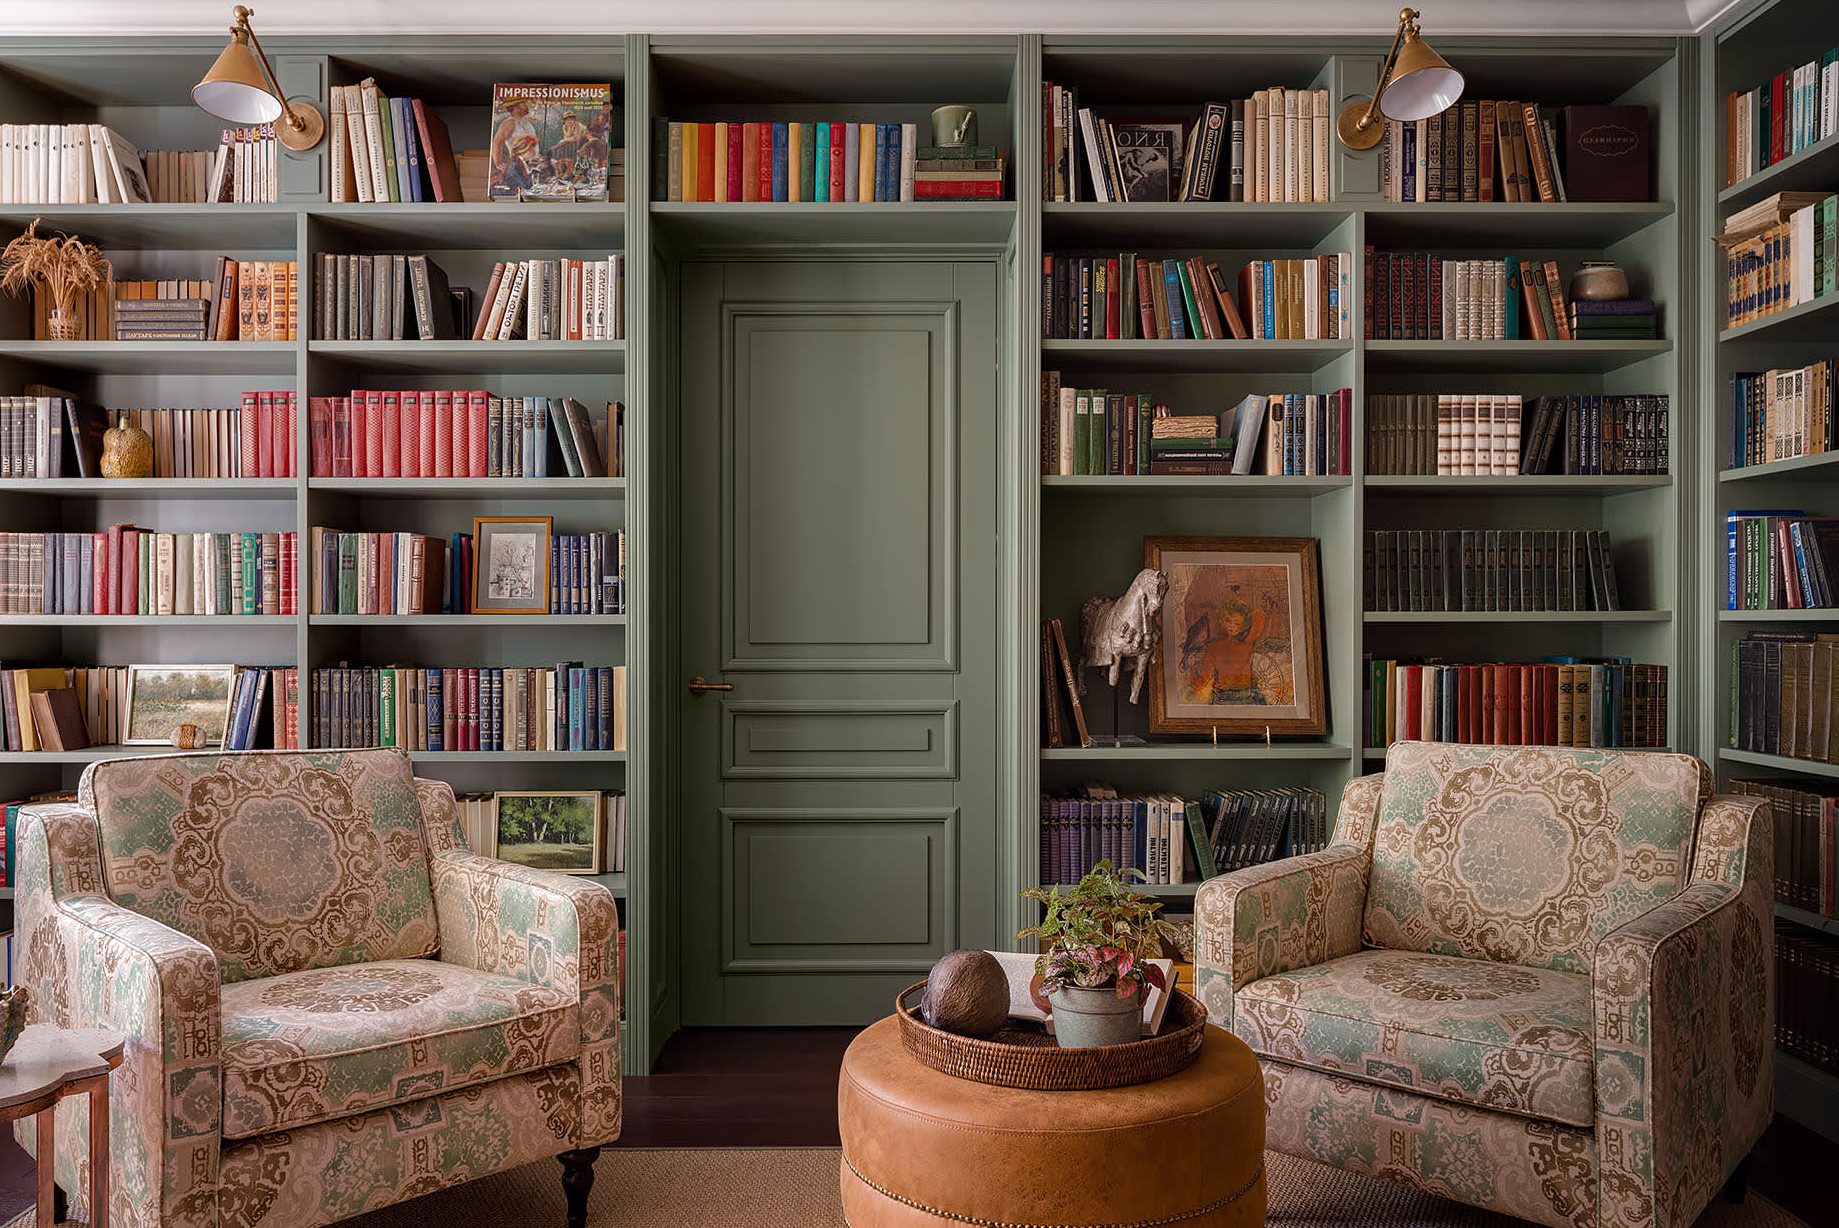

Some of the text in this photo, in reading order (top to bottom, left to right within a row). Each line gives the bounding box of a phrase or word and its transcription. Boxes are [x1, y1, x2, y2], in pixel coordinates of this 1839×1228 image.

[499, 88, 604, 98] IMPRESSIONISMUS
[598, 268, 606, 310] ПЛУТАРХ
[1377, 257, 1386, 326] ШЕКСПИР
[1392, 258, 1400, 326] ШЕКСПИР
[1404, 258, 1413, 326] ШЕКСПИР
[1417, 257, 1426, 326] ШЕКСПИР
[1430, 257, 1440, 326] ШЕКСПИР
